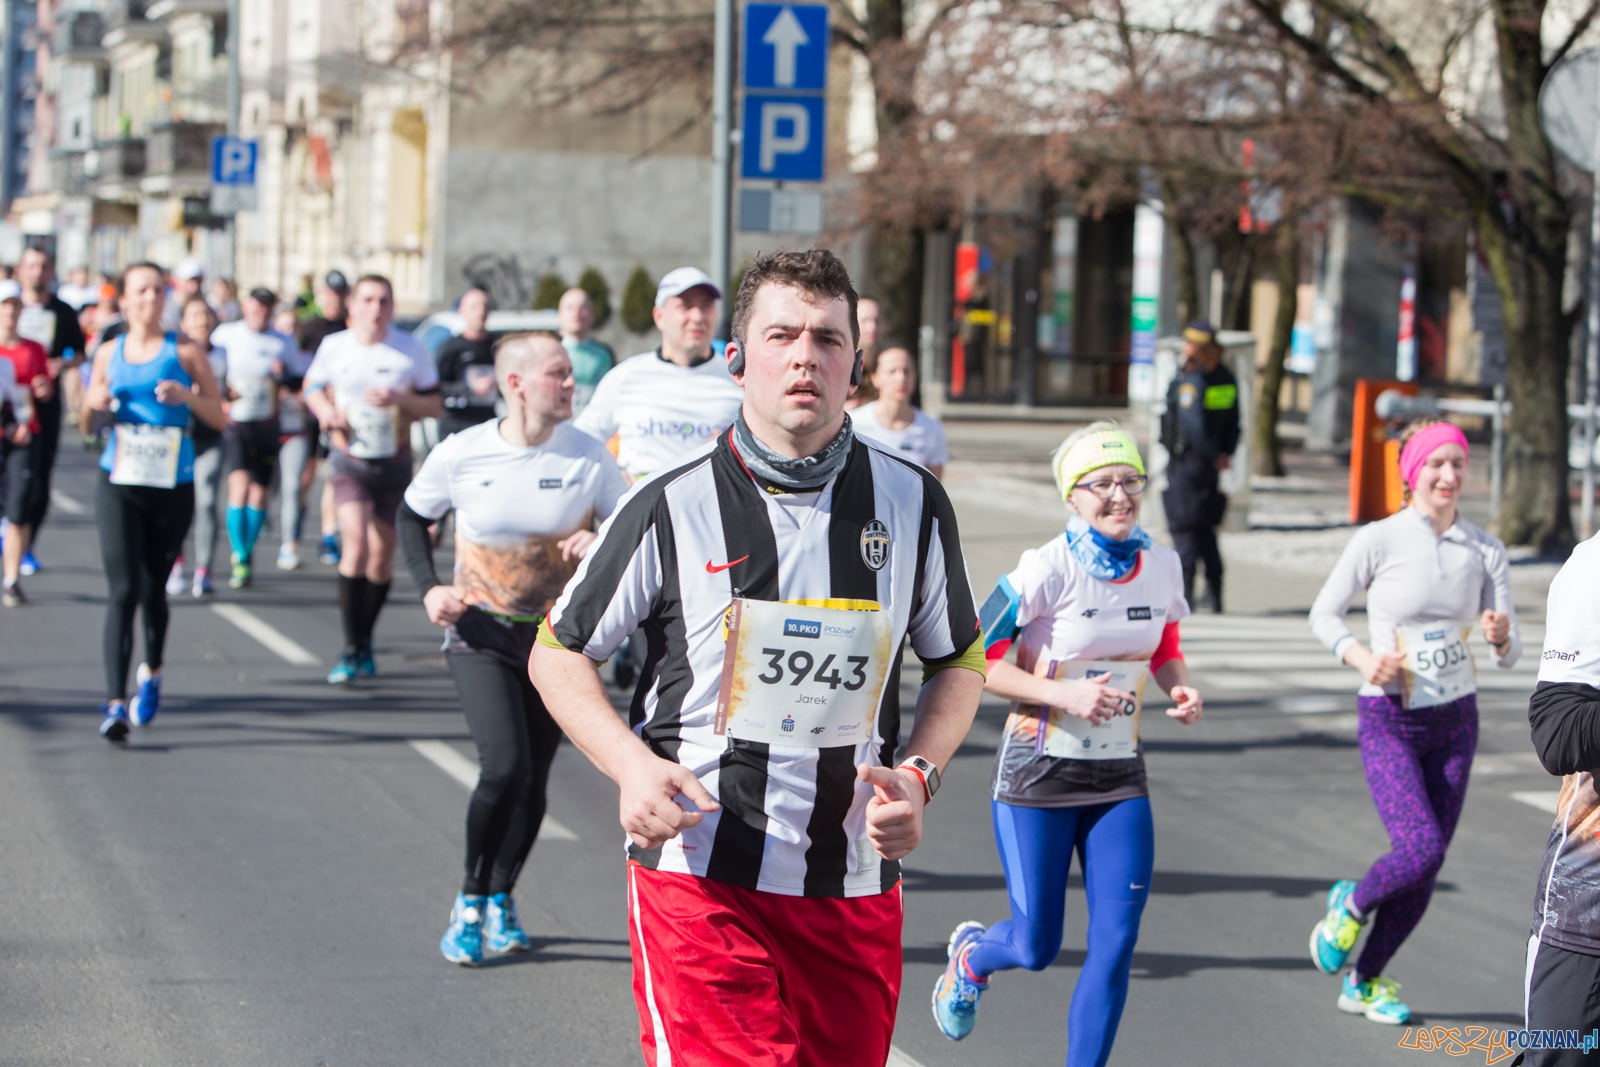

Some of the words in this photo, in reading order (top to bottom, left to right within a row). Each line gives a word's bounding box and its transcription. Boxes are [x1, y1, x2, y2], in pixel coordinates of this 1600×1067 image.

[758, 102, 810, 173] P
[221, 143, 252, 180] P
[787, 623, 799, 633] 10.
[799, 624, 819, 634] PKO
[758, 647, 869, 691] 3943
[795, 693, 828, 706] Jarek
